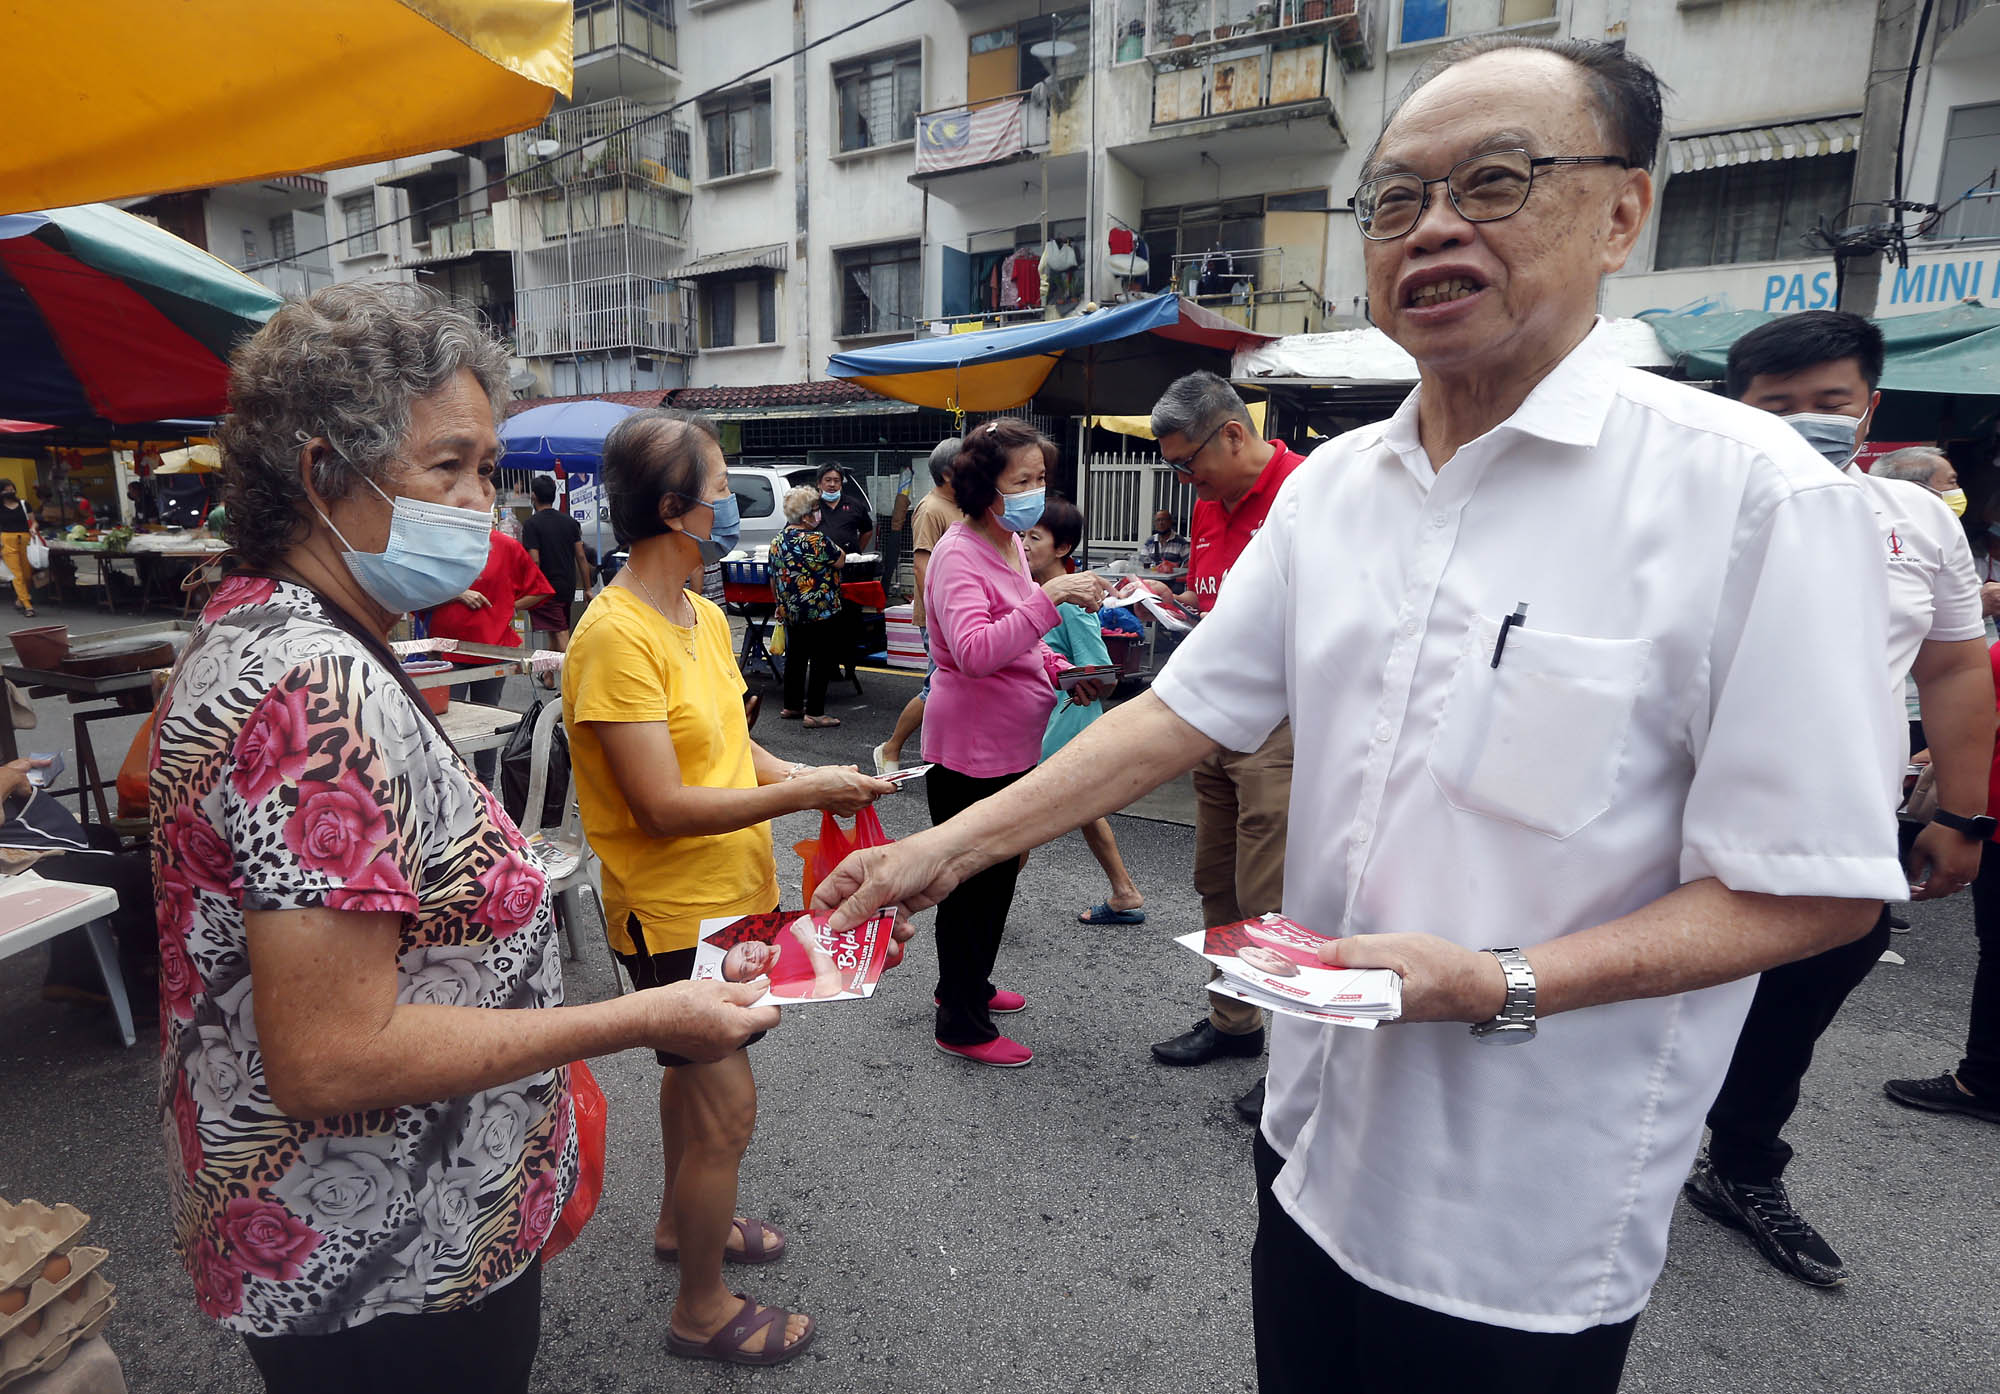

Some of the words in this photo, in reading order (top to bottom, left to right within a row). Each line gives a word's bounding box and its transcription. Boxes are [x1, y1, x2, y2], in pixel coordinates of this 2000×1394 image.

[1890, 261, 1984, 304] MINI
[814, 923, 839, 957] Kita
[837, 929, 860, 969] Boleh
